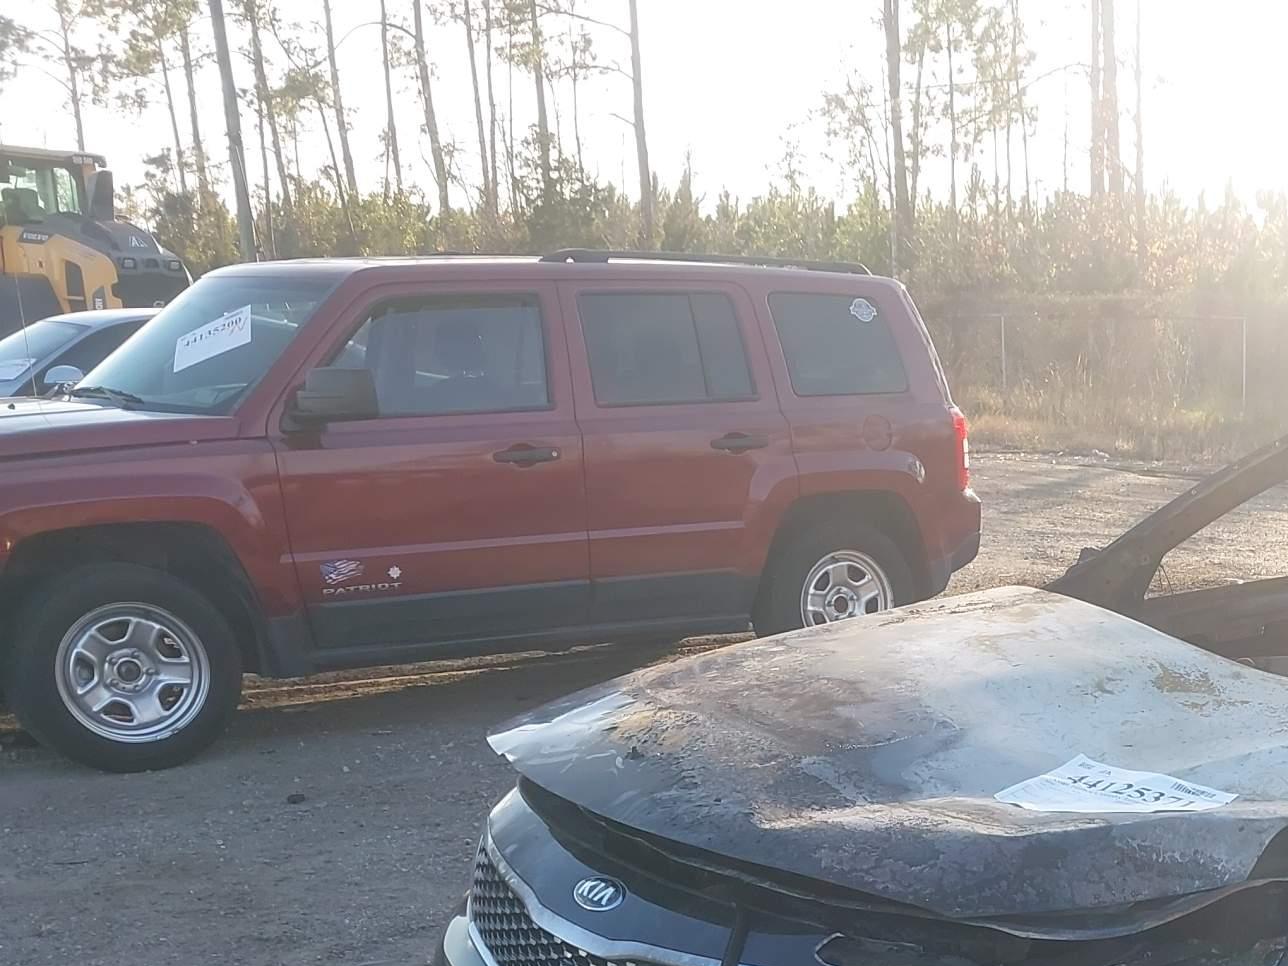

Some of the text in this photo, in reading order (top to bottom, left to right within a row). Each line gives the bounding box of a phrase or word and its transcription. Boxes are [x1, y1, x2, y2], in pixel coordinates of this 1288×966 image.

[322, 582, 402, 595] PATRIOT
[1067, 775, 1195, 808] 44125371
[578, 880, 616, 906] KIA
